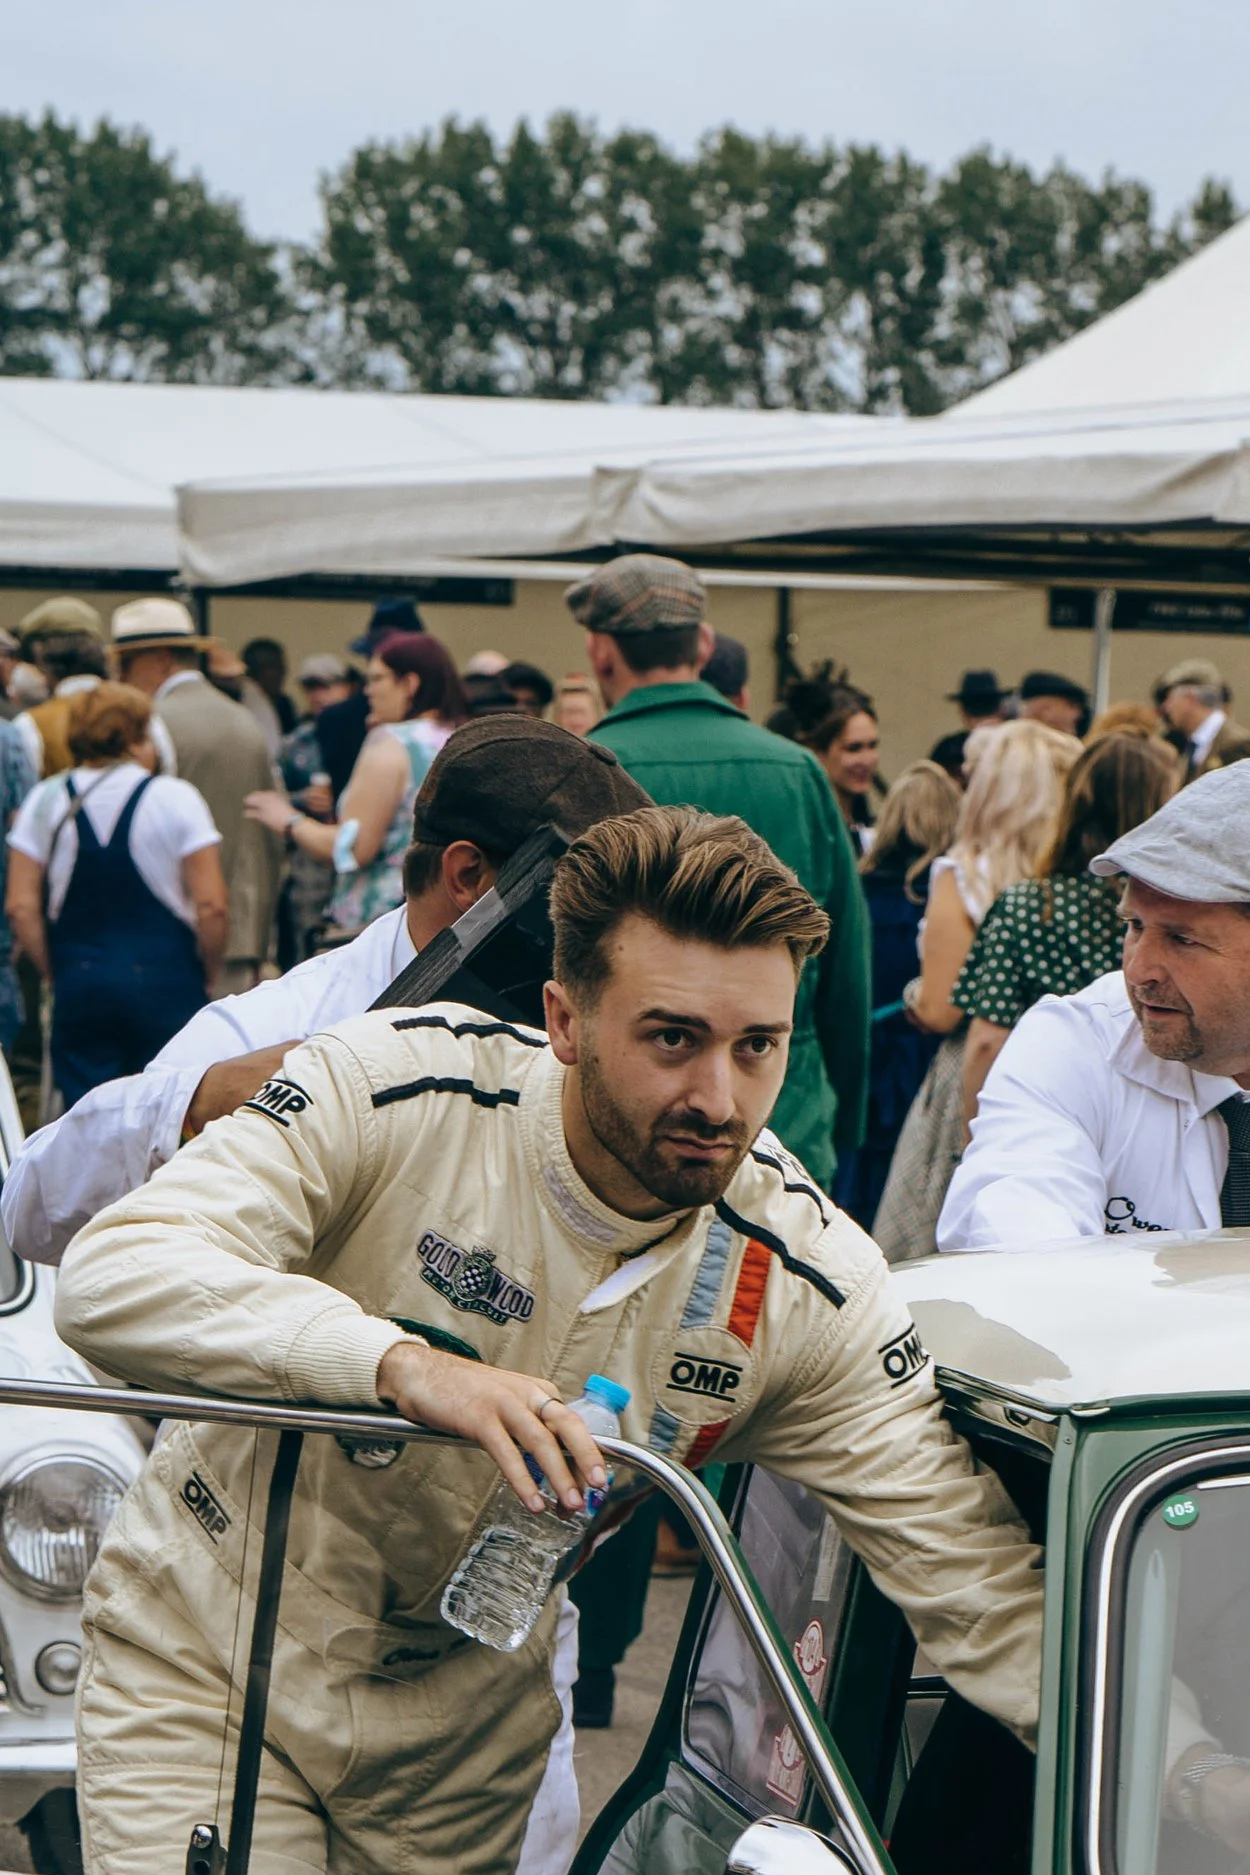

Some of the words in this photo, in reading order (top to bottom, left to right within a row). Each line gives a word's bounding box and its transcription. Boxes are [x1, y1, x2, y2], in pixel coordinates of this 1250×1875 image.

[670, 1360, 741, 1395] OMP
[184, 1479, 228, 1535] OMP
[1165, 1500, 1196, 1519] 105
